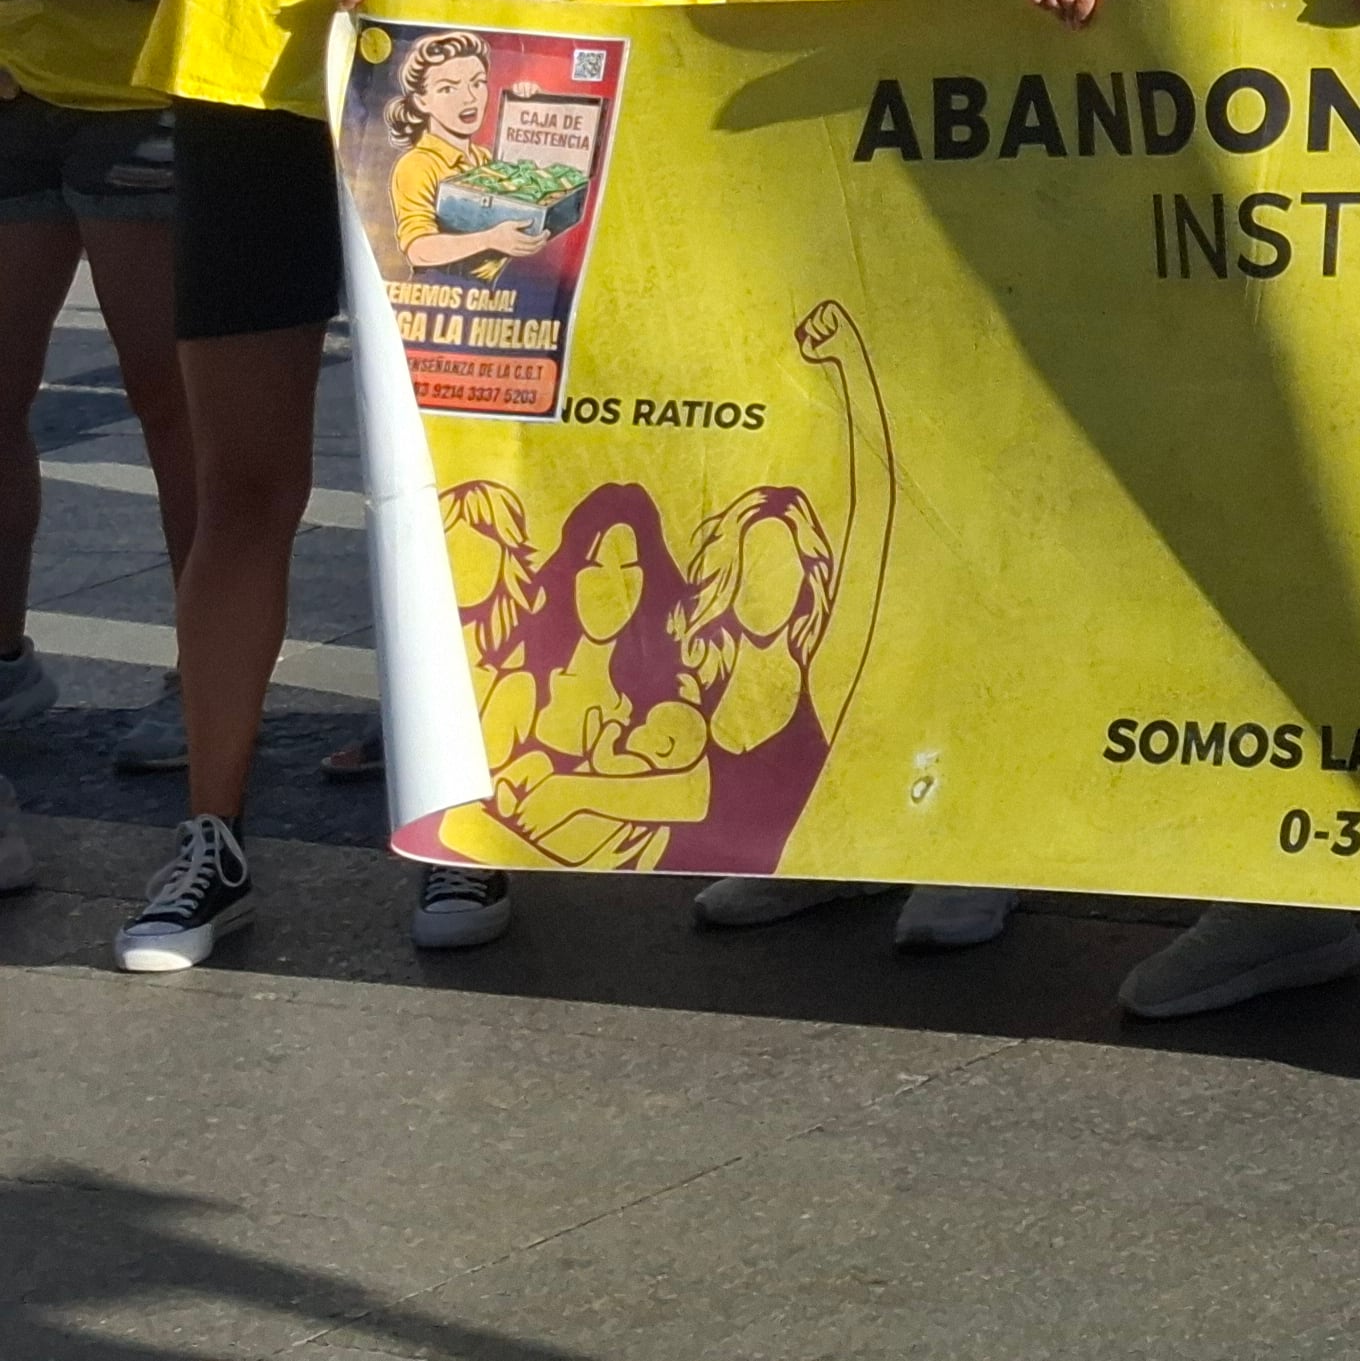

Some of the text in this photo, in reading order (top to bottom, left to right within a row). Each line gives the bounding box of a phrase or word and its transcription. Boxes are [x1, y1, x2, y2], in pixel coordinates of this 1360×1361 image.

[519, 108, 584, 131] CAJA DE
[505, 126, 591, 151] RESISTENCIA
[464, 287, 517, 313] CAJA!
[432, 313, 464, 346] LA
[467, 316, 561, 351] HUELGA!
[478, 360, 494, 378] DE
[496, 362, 511, 379] LA
[432, 383, 465, 400] 9214
[466, 386, 500, 404] 3337
[502, 389, 538, 405] 5203
[631, 398, 767, 431] RATIOS
[1102, 717, 1304, 771] SOMOS
